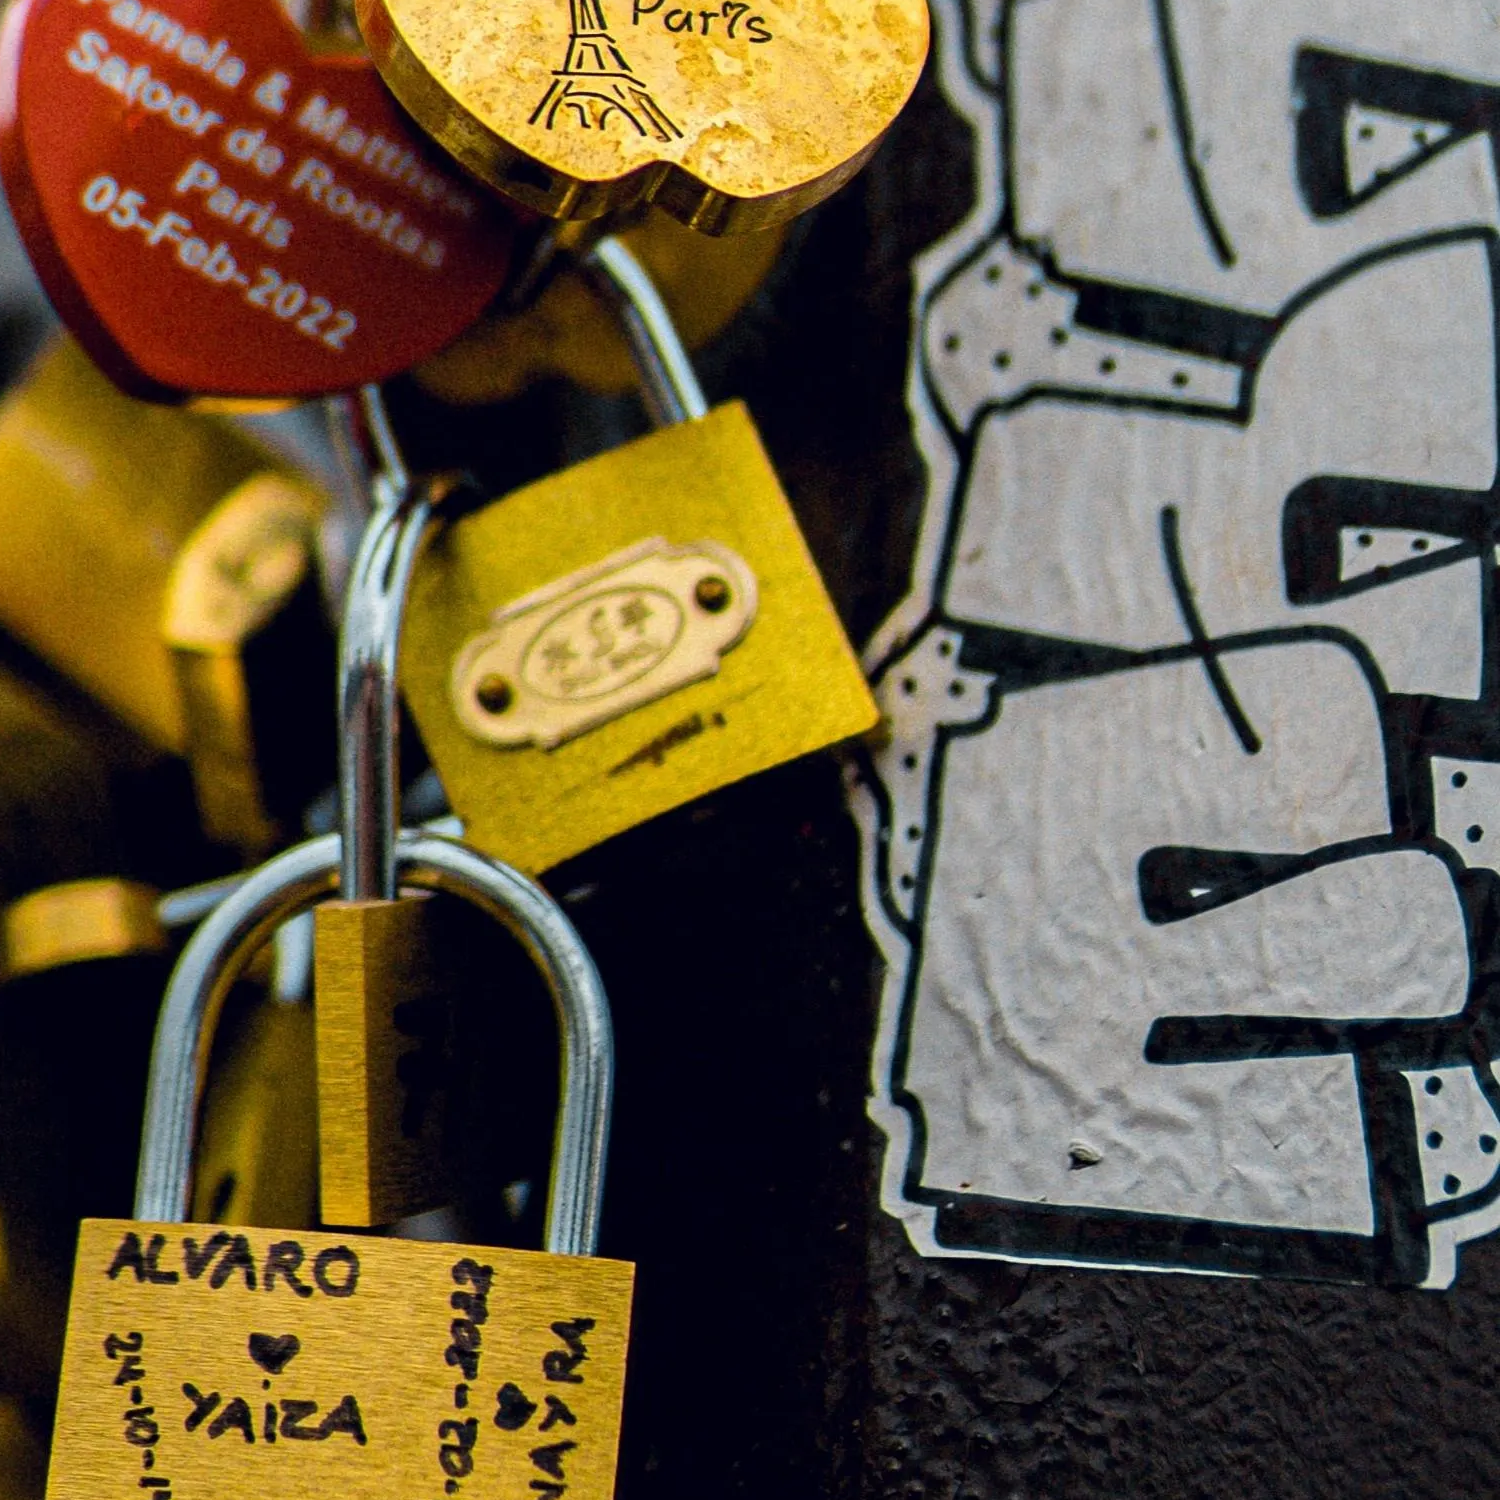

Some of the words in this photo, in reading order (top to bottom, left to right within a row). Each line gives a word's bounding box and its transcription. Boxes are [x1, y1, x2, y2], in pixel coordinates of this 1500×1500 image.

[67, 31, 223, 136] Satoor
[227, 125, 284, 176] de
[254, 72, 291, 113] &
[176, 160, 295, 249] Paris
[80, 176, 358, 351] 05-Feb-2022
[106, 1231, 361, 1298] ALVARO
